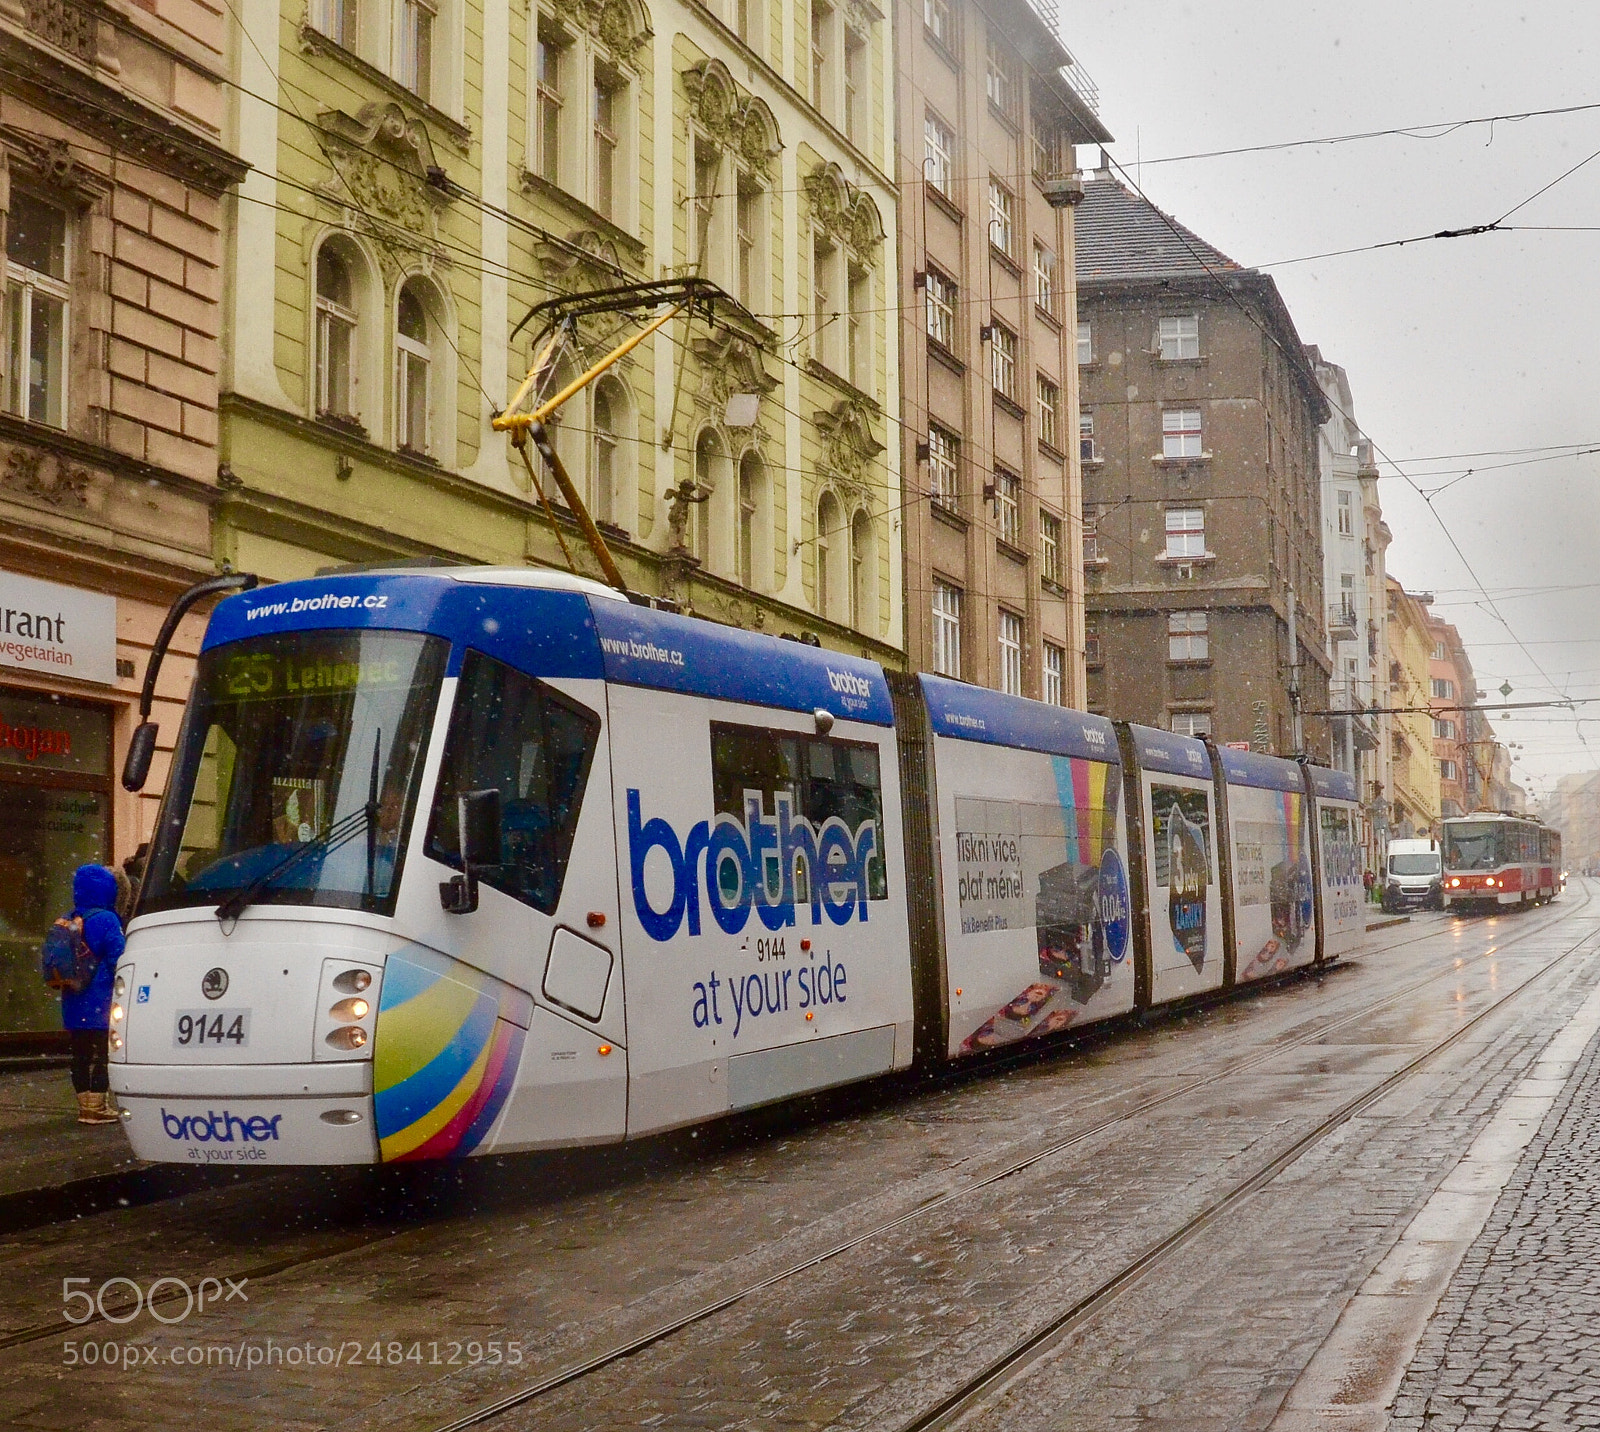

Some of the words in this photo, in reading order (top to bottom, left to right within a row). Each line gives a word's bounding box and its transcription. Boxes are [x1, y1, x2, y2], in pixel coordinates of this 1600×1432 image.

[246, 593, 389, 621] www.brother.cz
[0, 606, 66, 644] rant
[599, 637, 685, 666] www.brother.cz
[229, 652, 273, 695] 25
[826, 666, 871, 698] brother
[627, 788, 876, 942] brother
[757, 937, 786, 962] 9144
[692, 970, 722, 1029] at
[729, 968, 792, 1039] your
[799, 950, 848, 1006] side
[177, 1014, 245, 1046] 9144
[161, 1107, 283, 1143] brother
[188, 1146, 201, 1160] at
[202, 1148, 234, 1162] your
[237, 1146, 267, 1160] side
